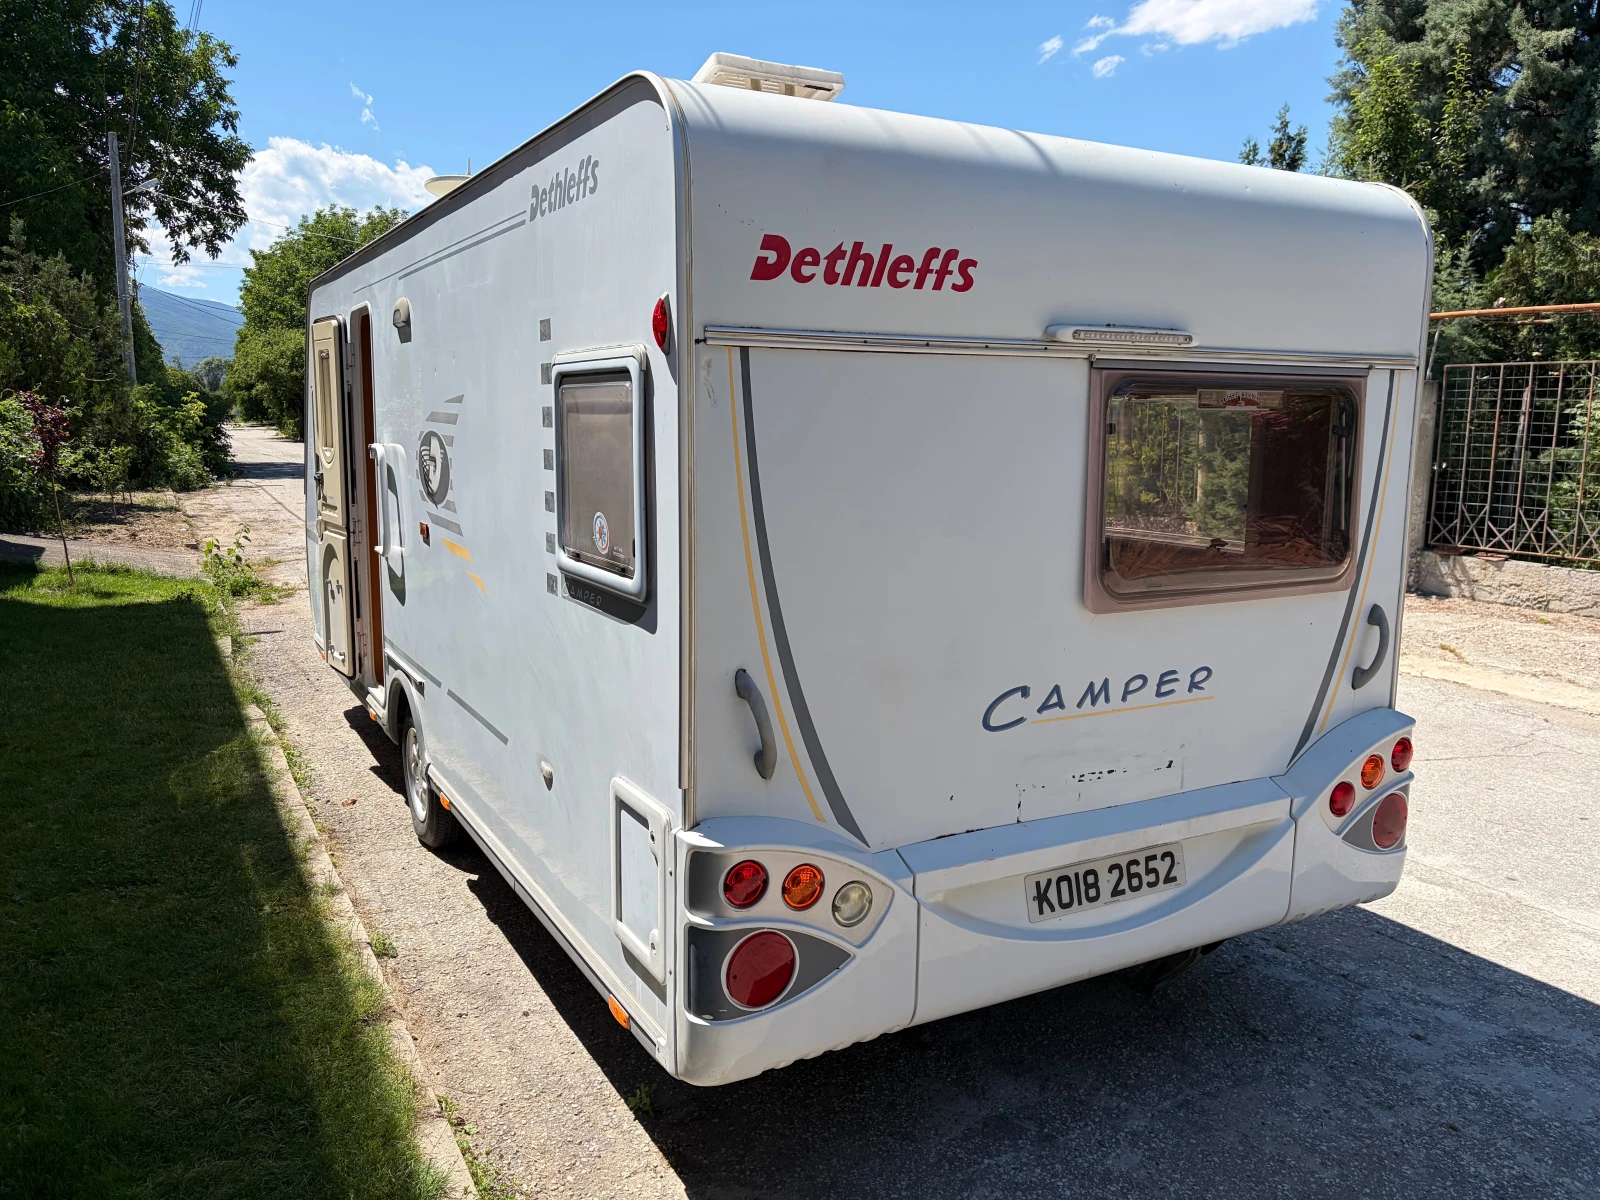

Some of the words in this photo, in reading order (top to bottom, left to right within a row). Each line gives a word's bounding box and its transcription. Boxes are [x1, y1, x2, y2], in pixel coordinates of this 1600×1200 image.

[529, 154, 599, 222] Dethleffs
[750, 233, 979, 293] Dethleffs
[562, 583, 602, 606] CAMPER
[981, 665, 1213, 732] CAMPER
[1107, 850, 1178, 898] 2652
